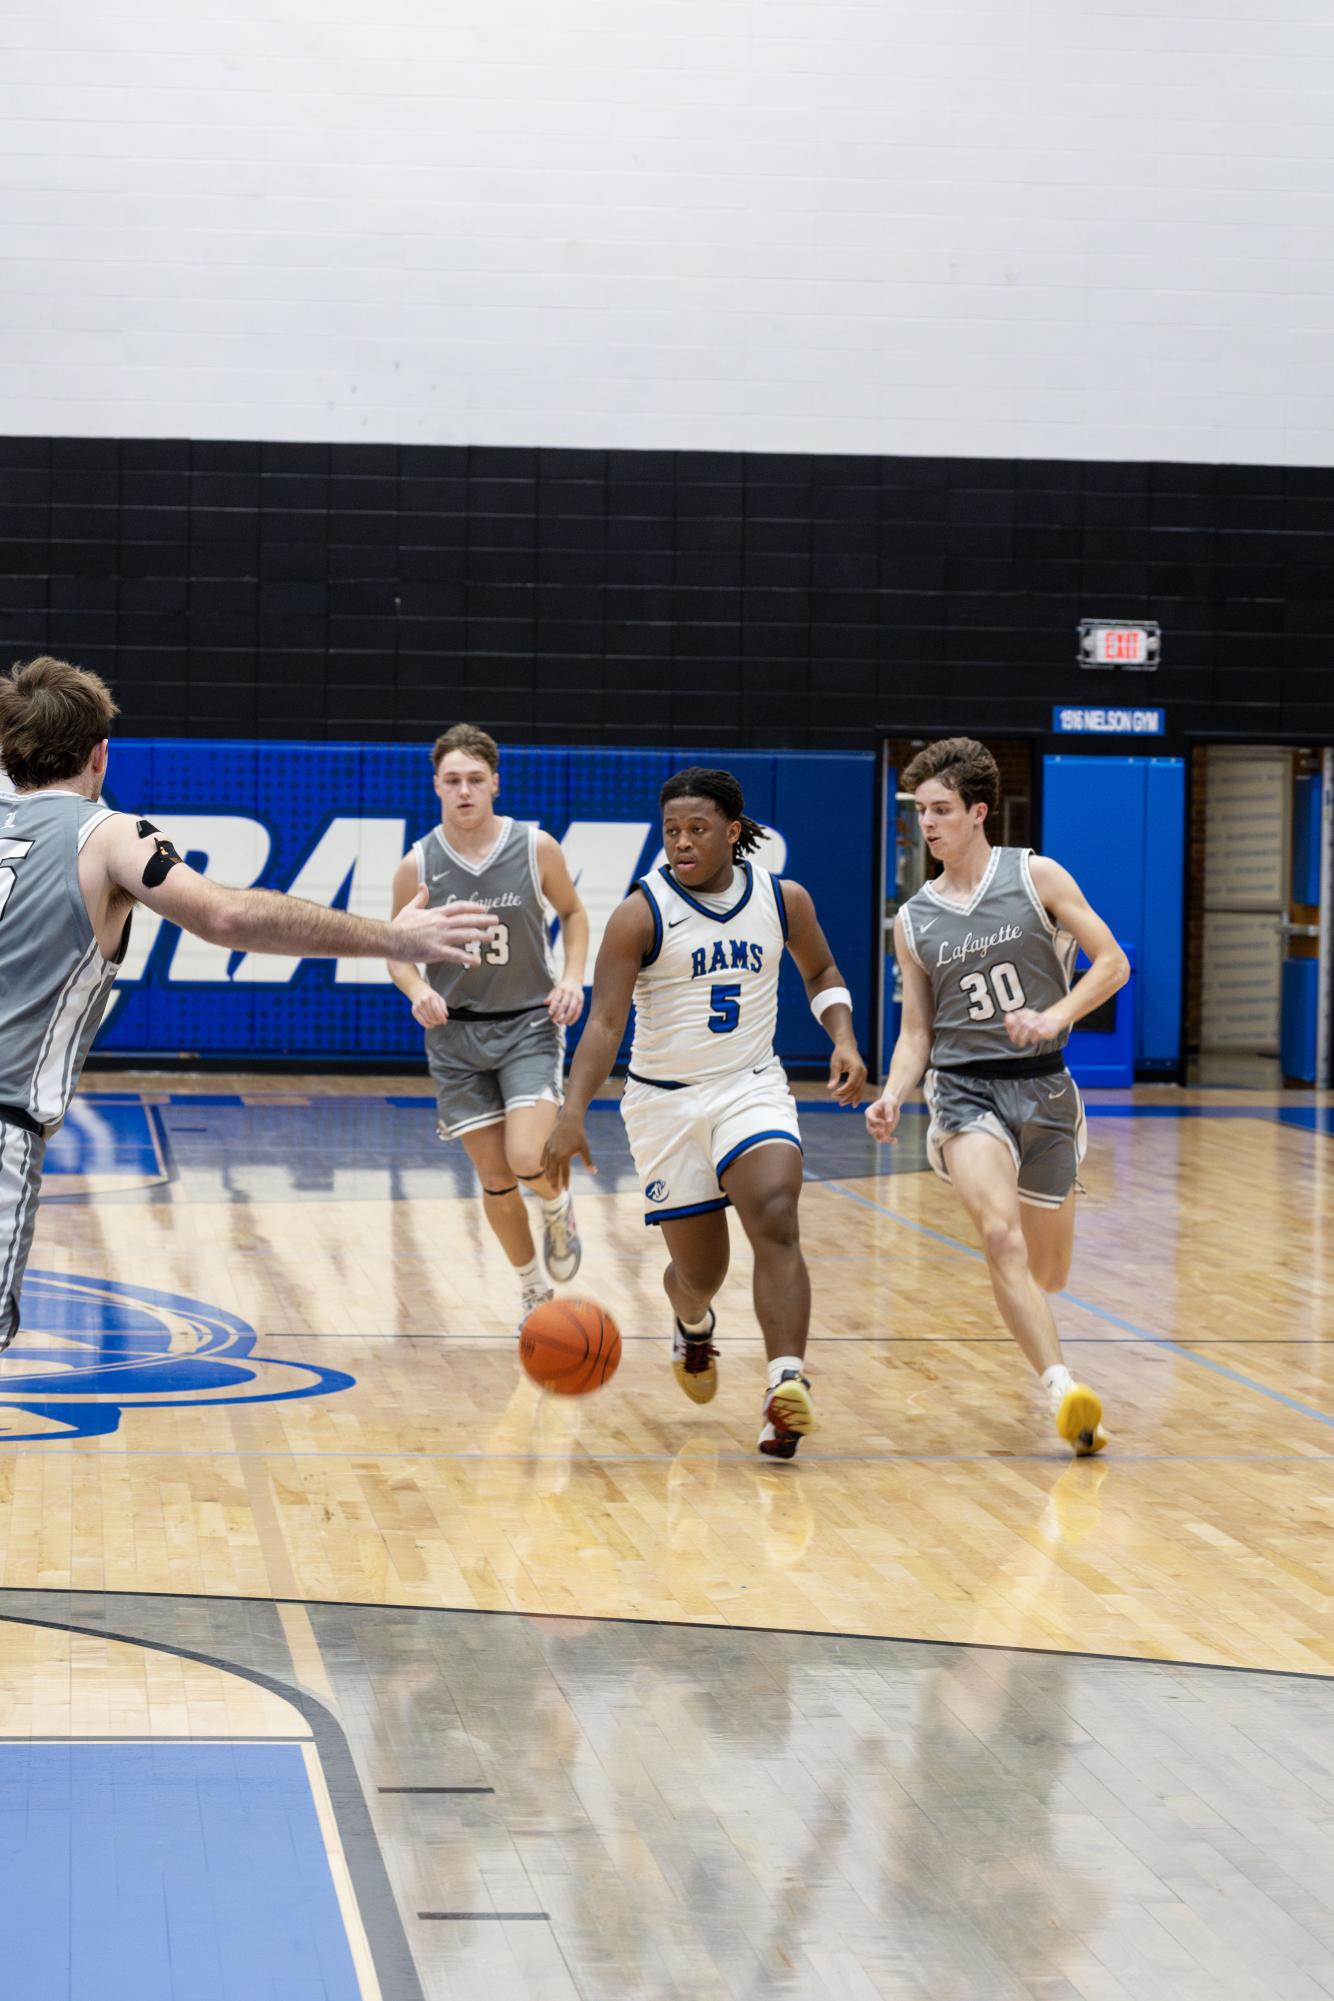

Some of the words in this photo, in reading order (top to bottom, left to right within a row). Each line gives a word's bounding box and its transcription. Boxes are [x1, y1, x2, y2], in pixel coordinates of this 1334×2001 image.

[1105, 631, 1138, 658] EXIT
[1084, 710, 1132, 731] NELSON
[1133, 711, 1158, 732] GYM
[446, 891, 522, 913] Lfayette
[691, 939, 763, 980] RAMS
[936, 924, 1022, 967] Lafayette
[707, 983, 741, 1033] 5
[959, 960, 1026, 1022] 30
